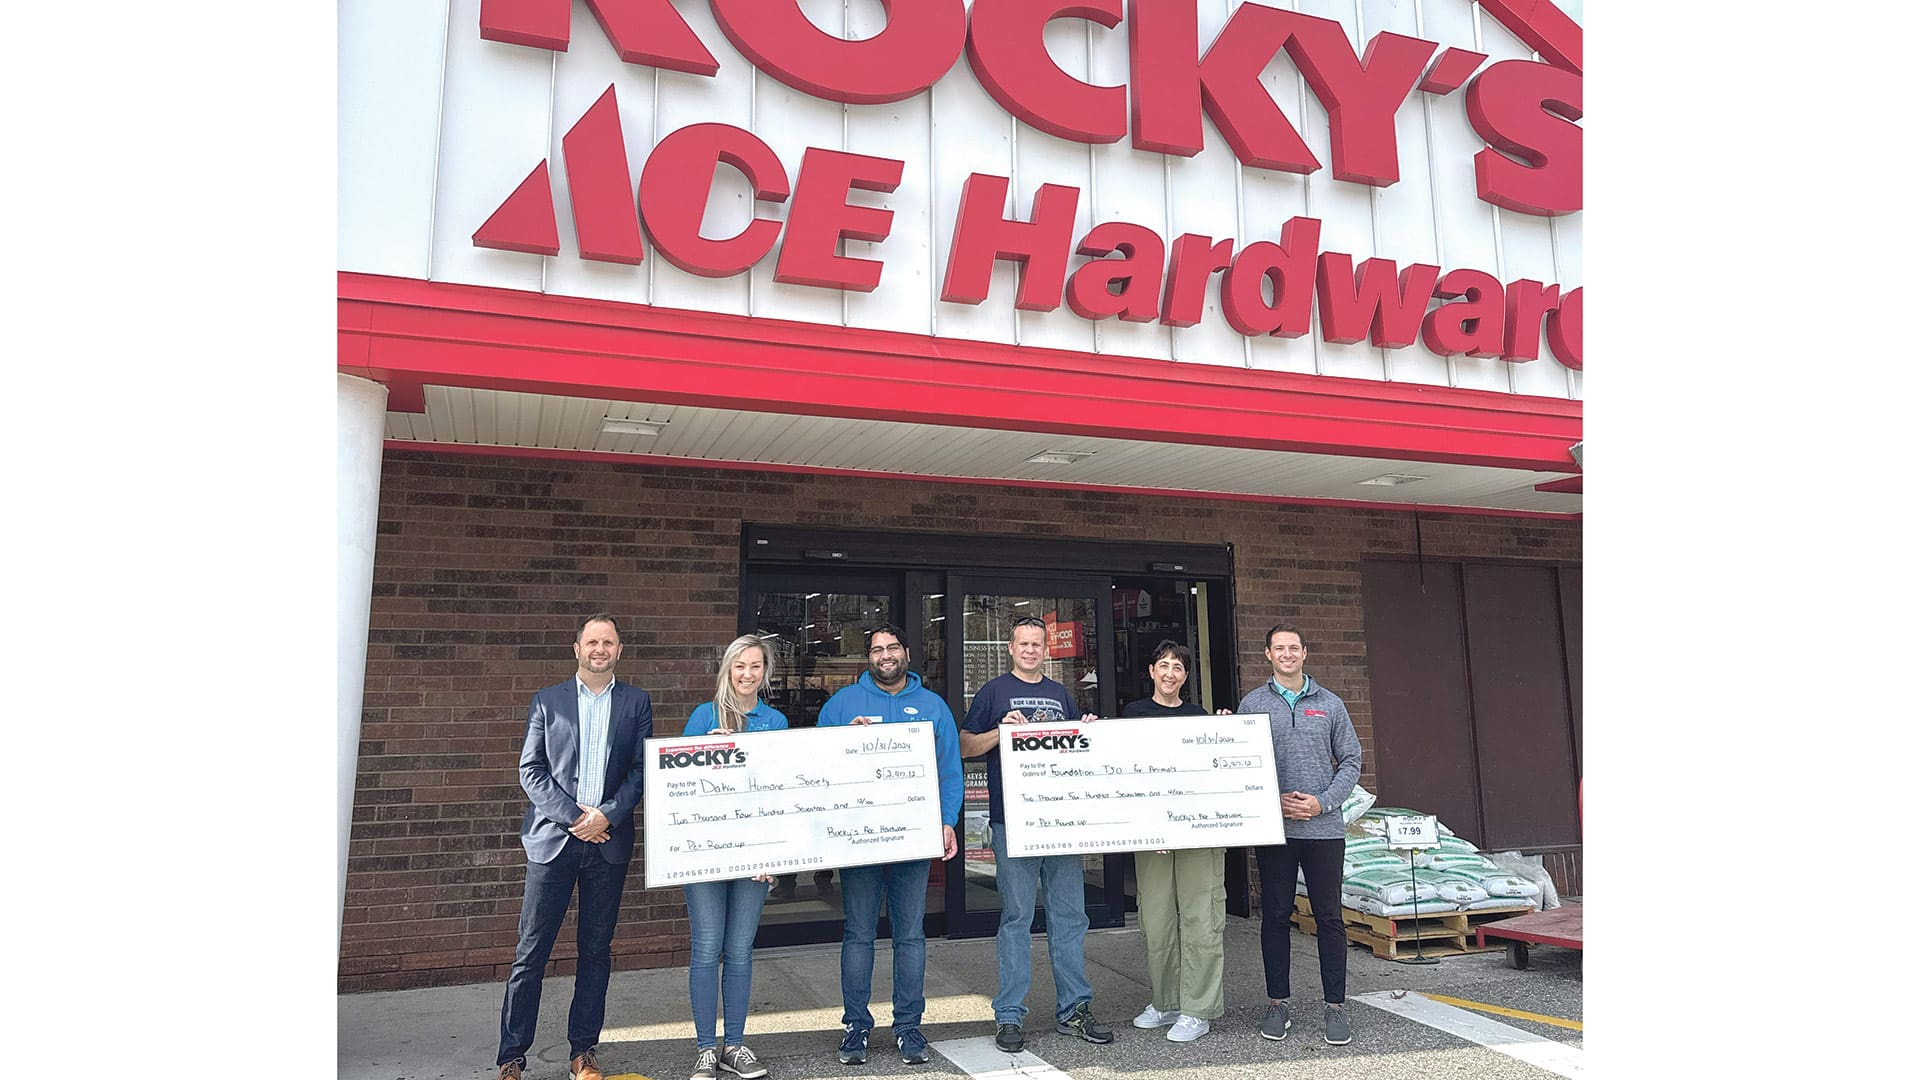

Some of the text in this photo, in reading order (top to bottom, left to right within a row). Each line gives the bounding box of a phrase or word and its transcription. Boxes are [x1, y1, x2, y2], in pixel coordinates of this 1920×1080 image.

[472, 82, 905, 293] ACE
[862, 737, 911, 752] 10/31/2024
[1212, 758, 1219, 768] $
[875, 768, 882, 779] $
[1050, 763, 1095, 776] Foundation
[699, 778, 736, 793] Dakin
[795, 774, 830, 787] Society
[668, 812, 689, 826] Two
[734, 809, 753, 819] Four
[1219, 821, 1244, 829] Signature
[1398, 826, 1422, 836] $7.99
[851, 834, 905, 845] Authorized Signature
[1024, 842, 1073, 850] 123456789
[666, 867, 721, 879] 123456789
